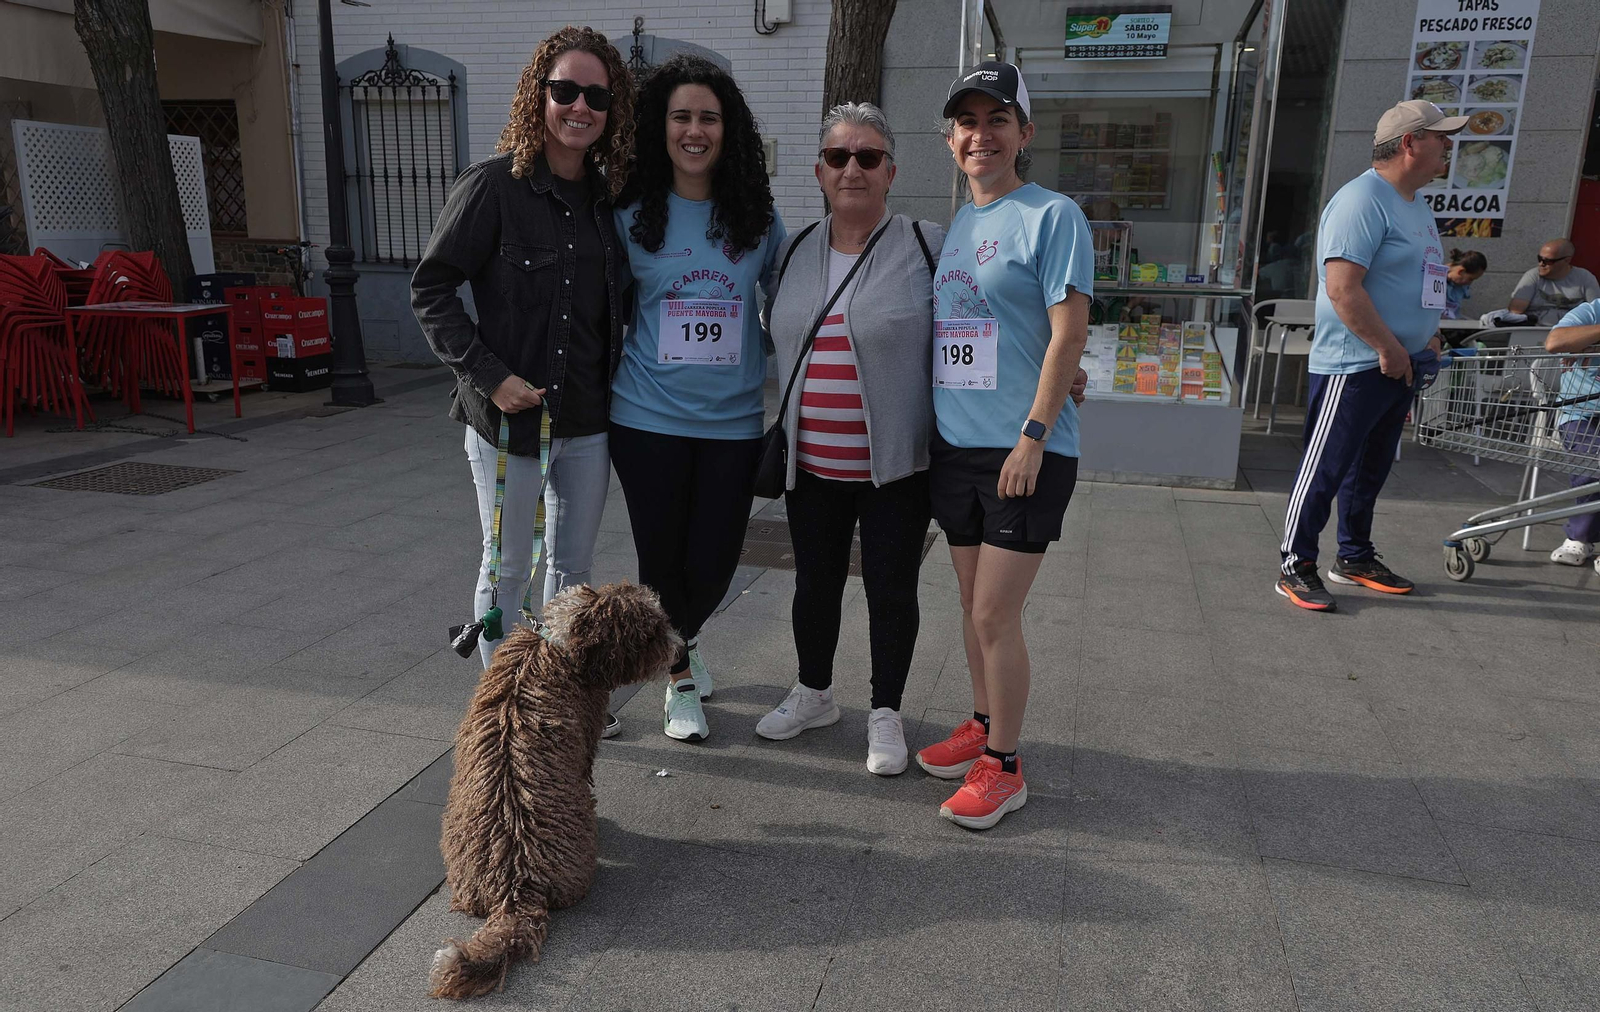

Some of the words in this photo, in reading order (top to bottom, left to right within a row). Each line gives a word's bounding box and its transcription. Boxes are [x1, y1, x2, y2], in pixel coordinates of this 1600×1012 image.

[1069, 23, 1096, 32] Super
[1420, 17, 1478, 32] PESCADO
[1482, 16, 1533, 31] FRESCO
[672, 269, 735, 293] CARRERA
[935, 269, 979, 296] CARRERA
[668, 301, 684, 310] VIII
[264, 312, 292, 320] Cruzcampo
[298, 309, 325, 319] Cruzcampo
[681, 322, 722, 342] 199
[984, 323, 992, 331] 11
[301, 336, 327, 347] Cruzcampo
[941, 344, 974, 366] 198
[307, 368, 329, 377] HEINEKEN
